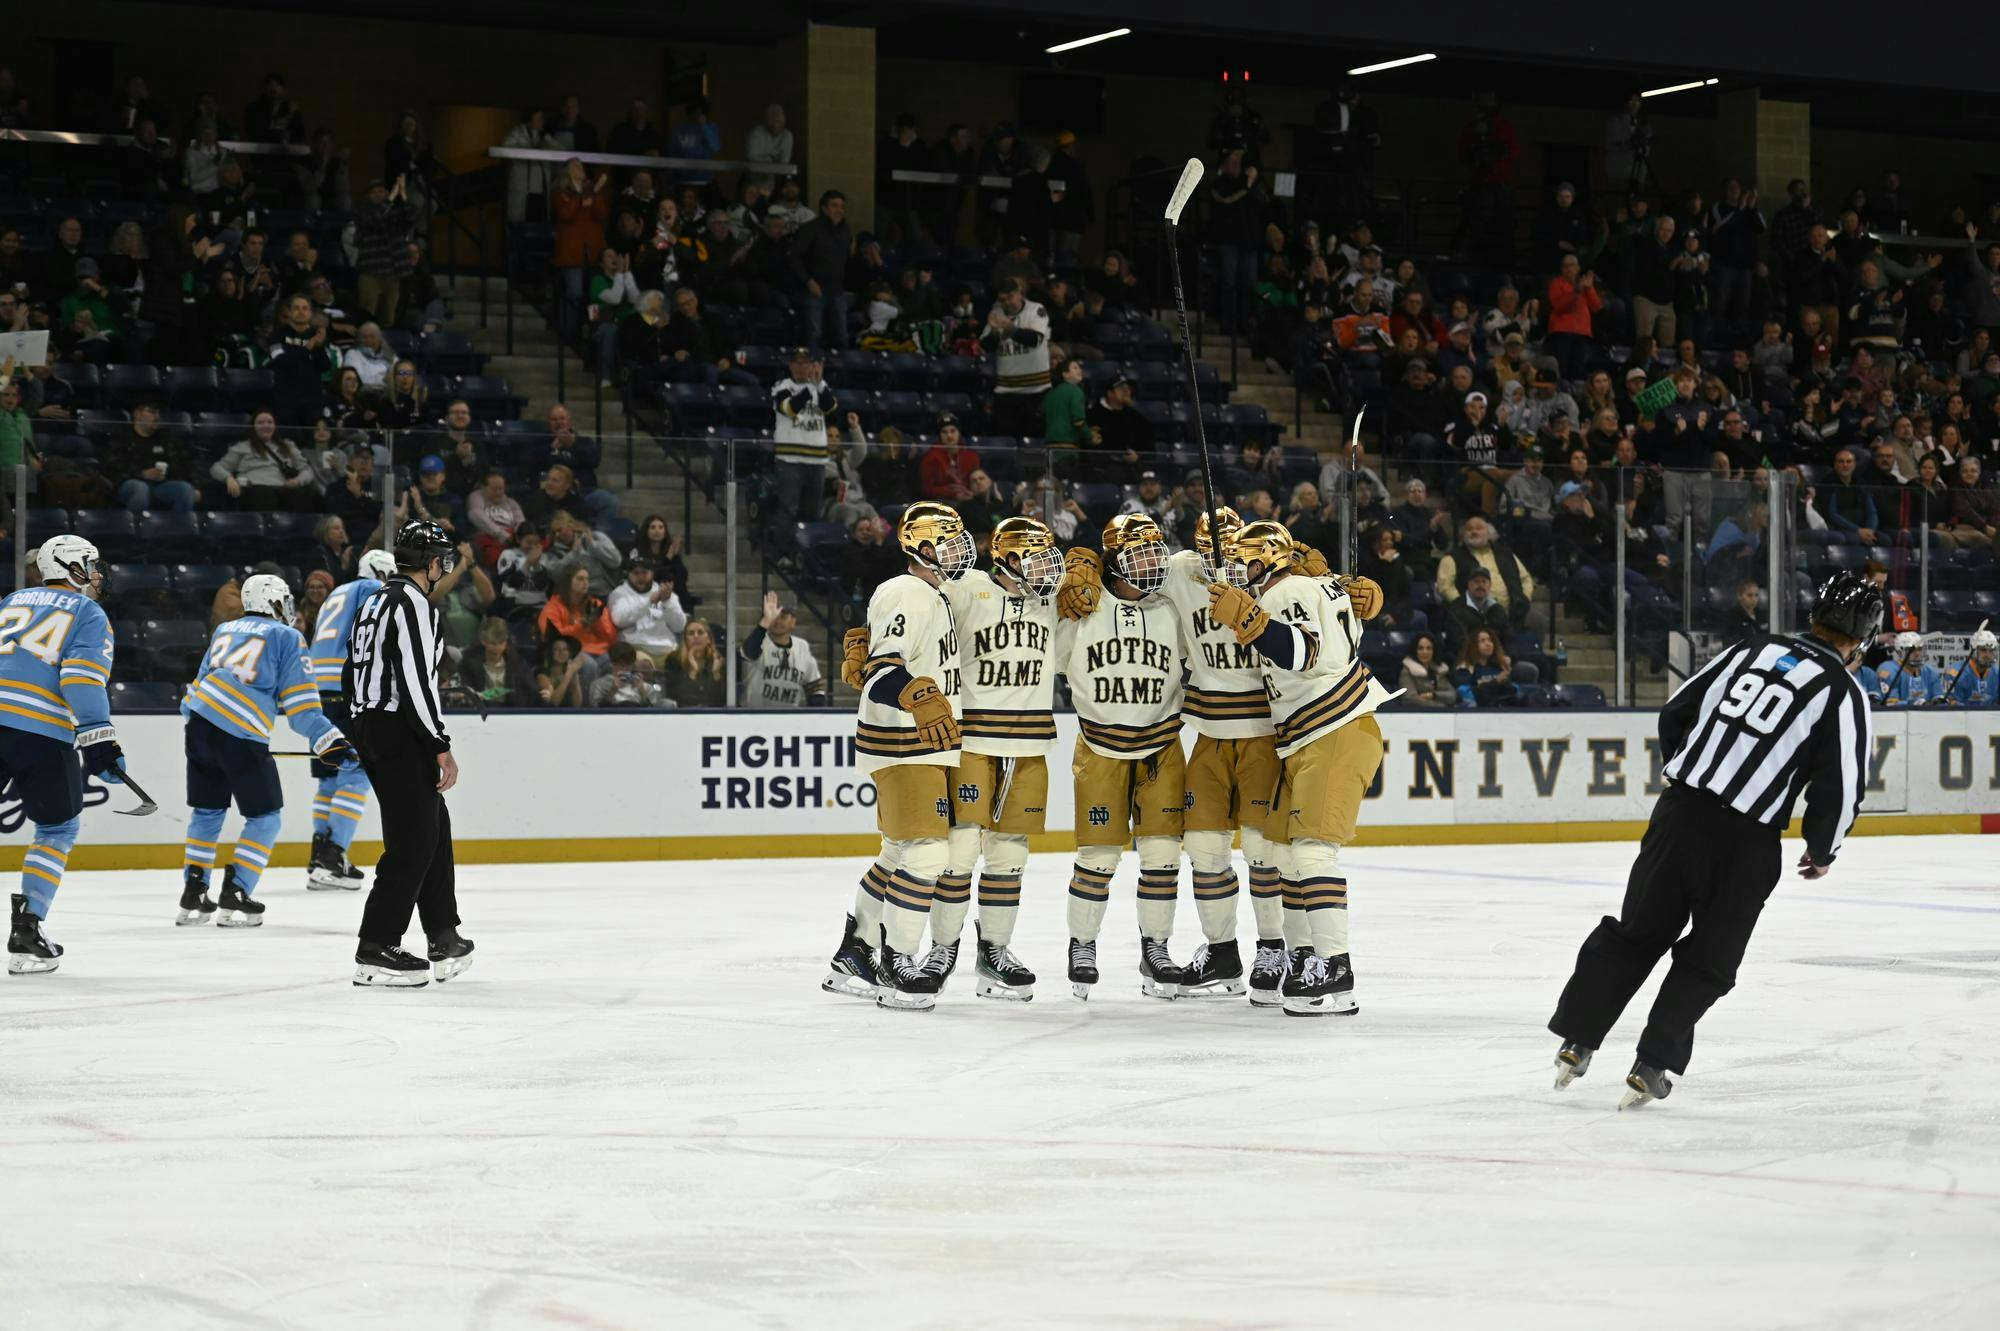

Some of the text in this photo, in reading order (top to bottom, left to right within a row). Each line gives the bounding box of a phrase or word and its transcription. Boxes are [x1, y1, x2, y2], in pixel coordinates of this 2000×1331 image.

[882, 613, 906, 639] 13
[1282, 602, 1310, 622] 14
[0, 607, 75, 668] 24
[352, 623, 375, 664] 92
[974, 620, 1050, 658] NOTRE
[1087, 637, 1172, 674] NOTRE
[976, 660, 1043, 687] DAME
[762, 683, 800, 704] DAME
[1094, 677, 1165, 704] DAME
[1719, 672, 1794, 735] 90
